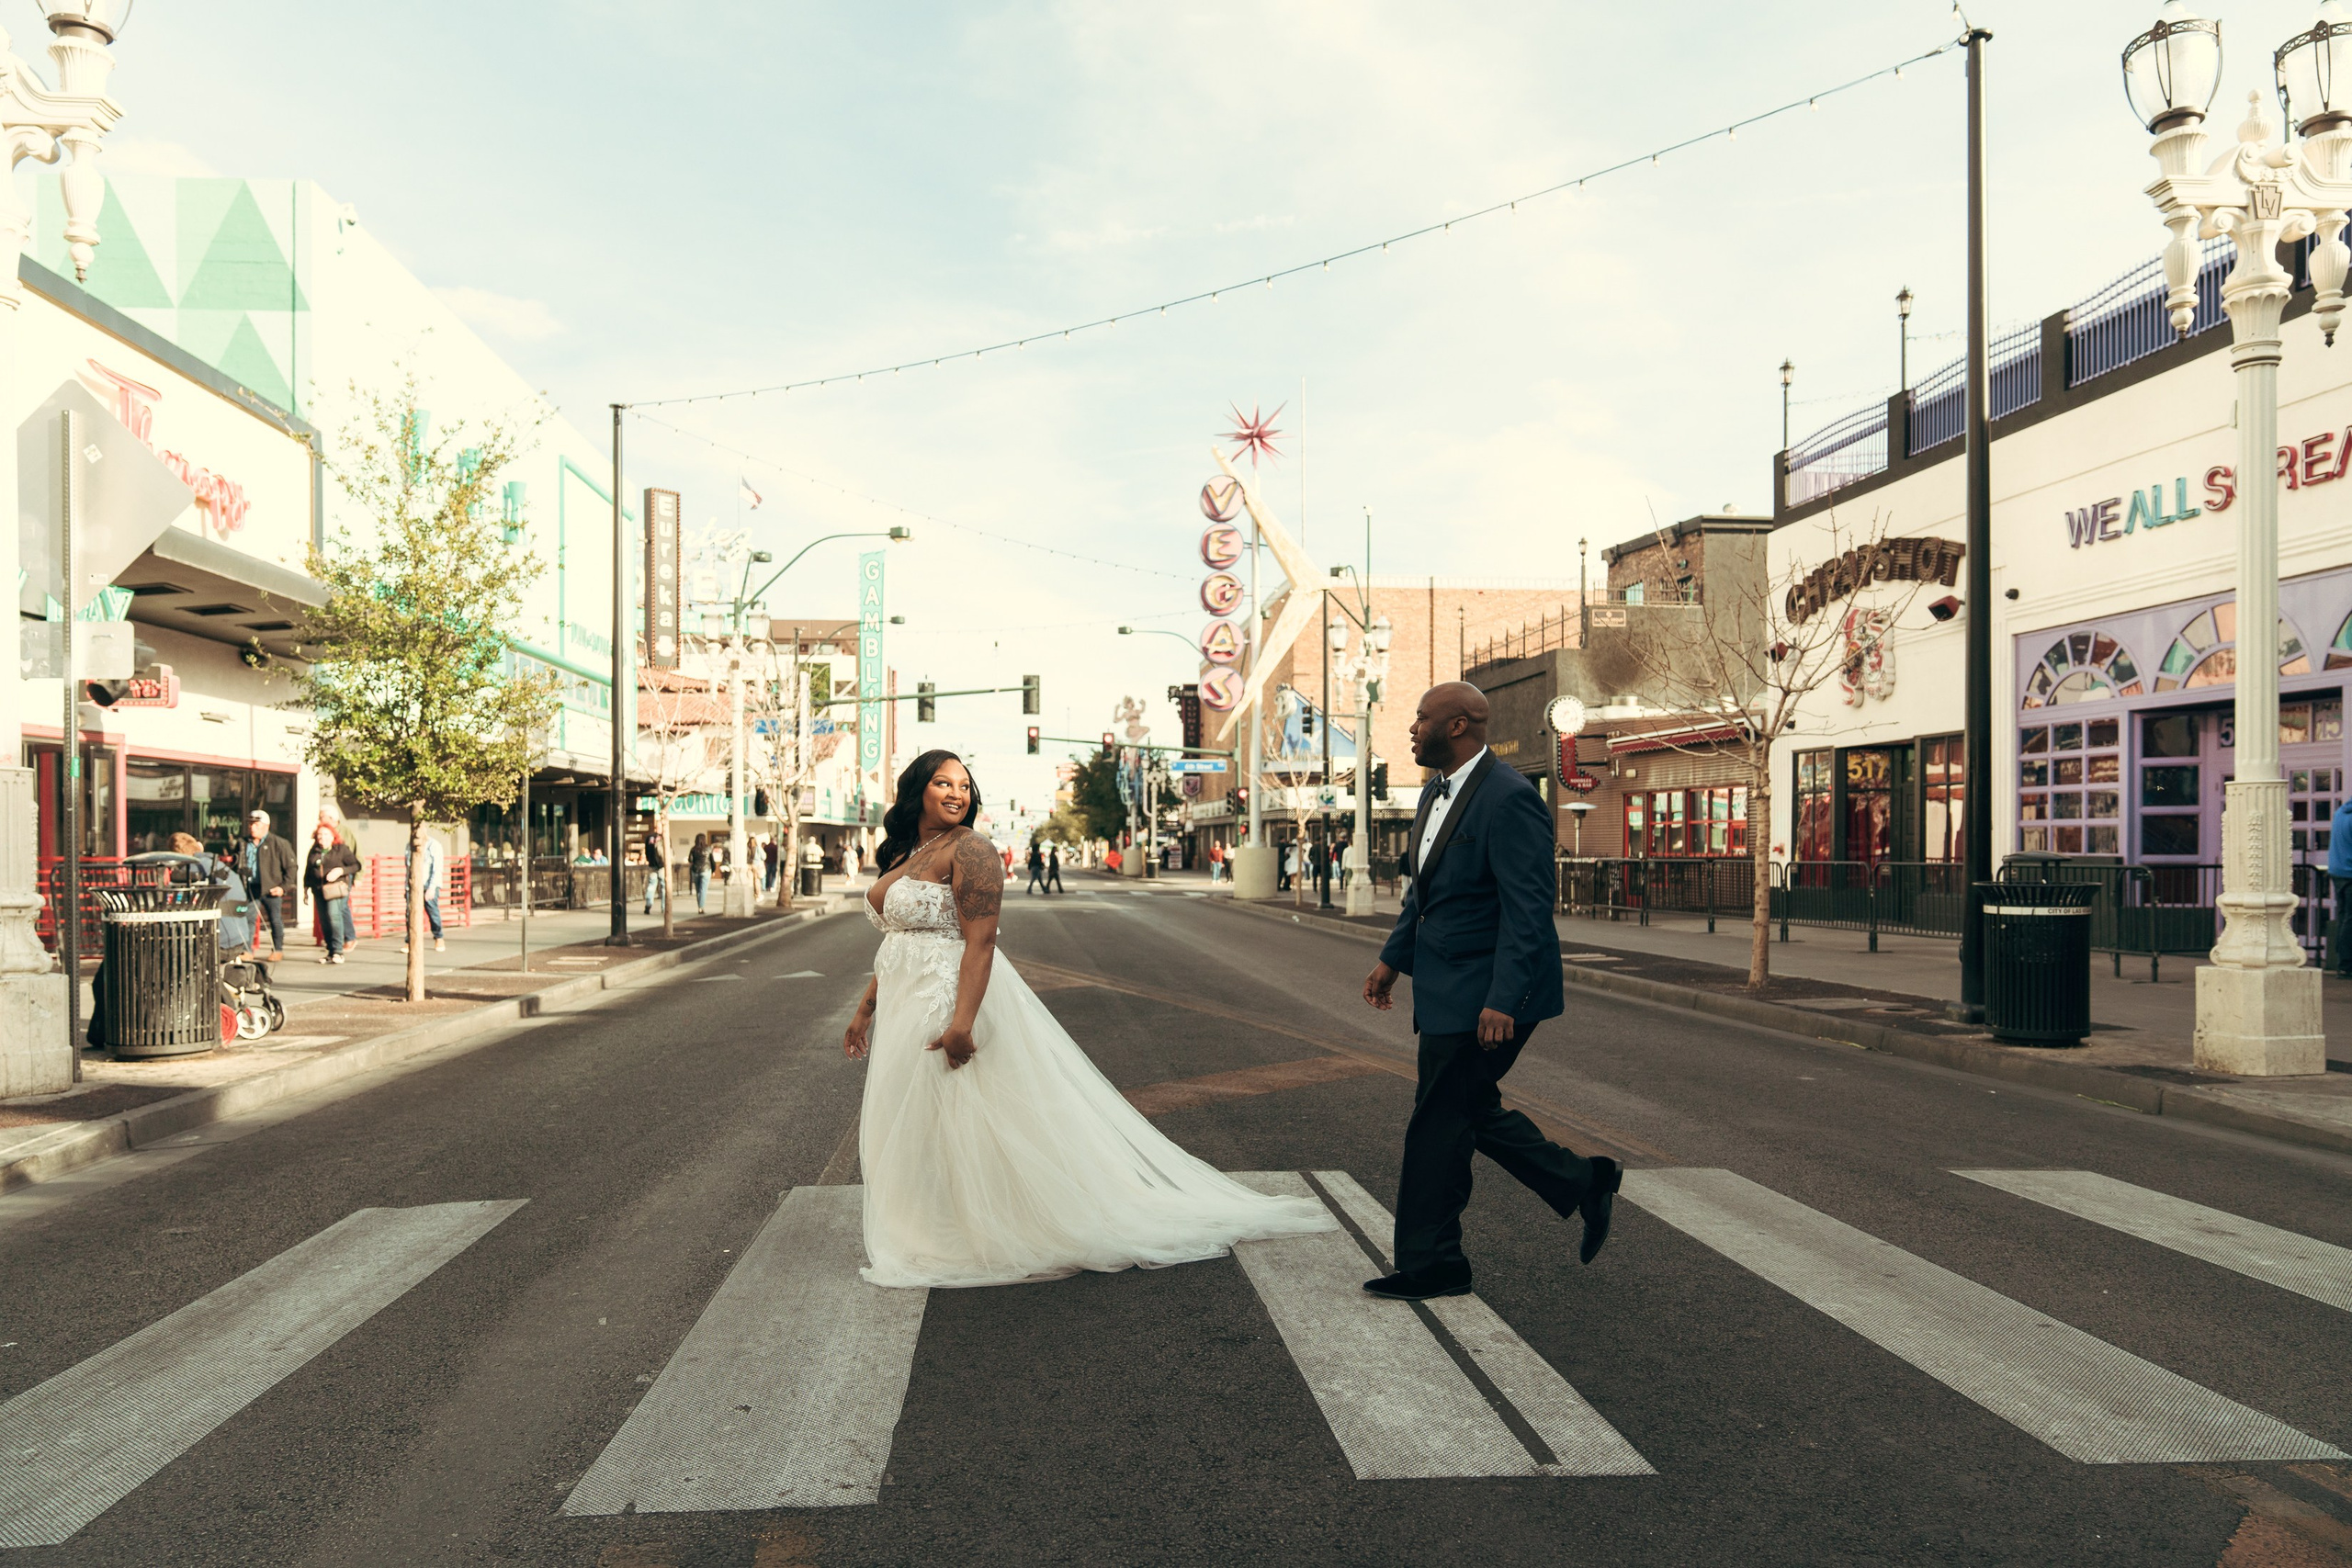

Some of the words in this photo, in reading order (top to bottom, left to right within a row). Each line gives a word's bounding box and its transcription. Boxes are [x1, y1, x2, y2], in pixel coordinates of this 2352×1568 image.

[86, 358, 251, 531] Thrapy
[2064, 497, 2121, 549] WE
[2123, 477, 2200, 535] ALL
[658, 495, 673, 627] Eureka
[1202, 479, 1241, 710] VEGAS
[863, 560, 880, 760] GAMBLING
[1848, 754, 1890, 779] 517
